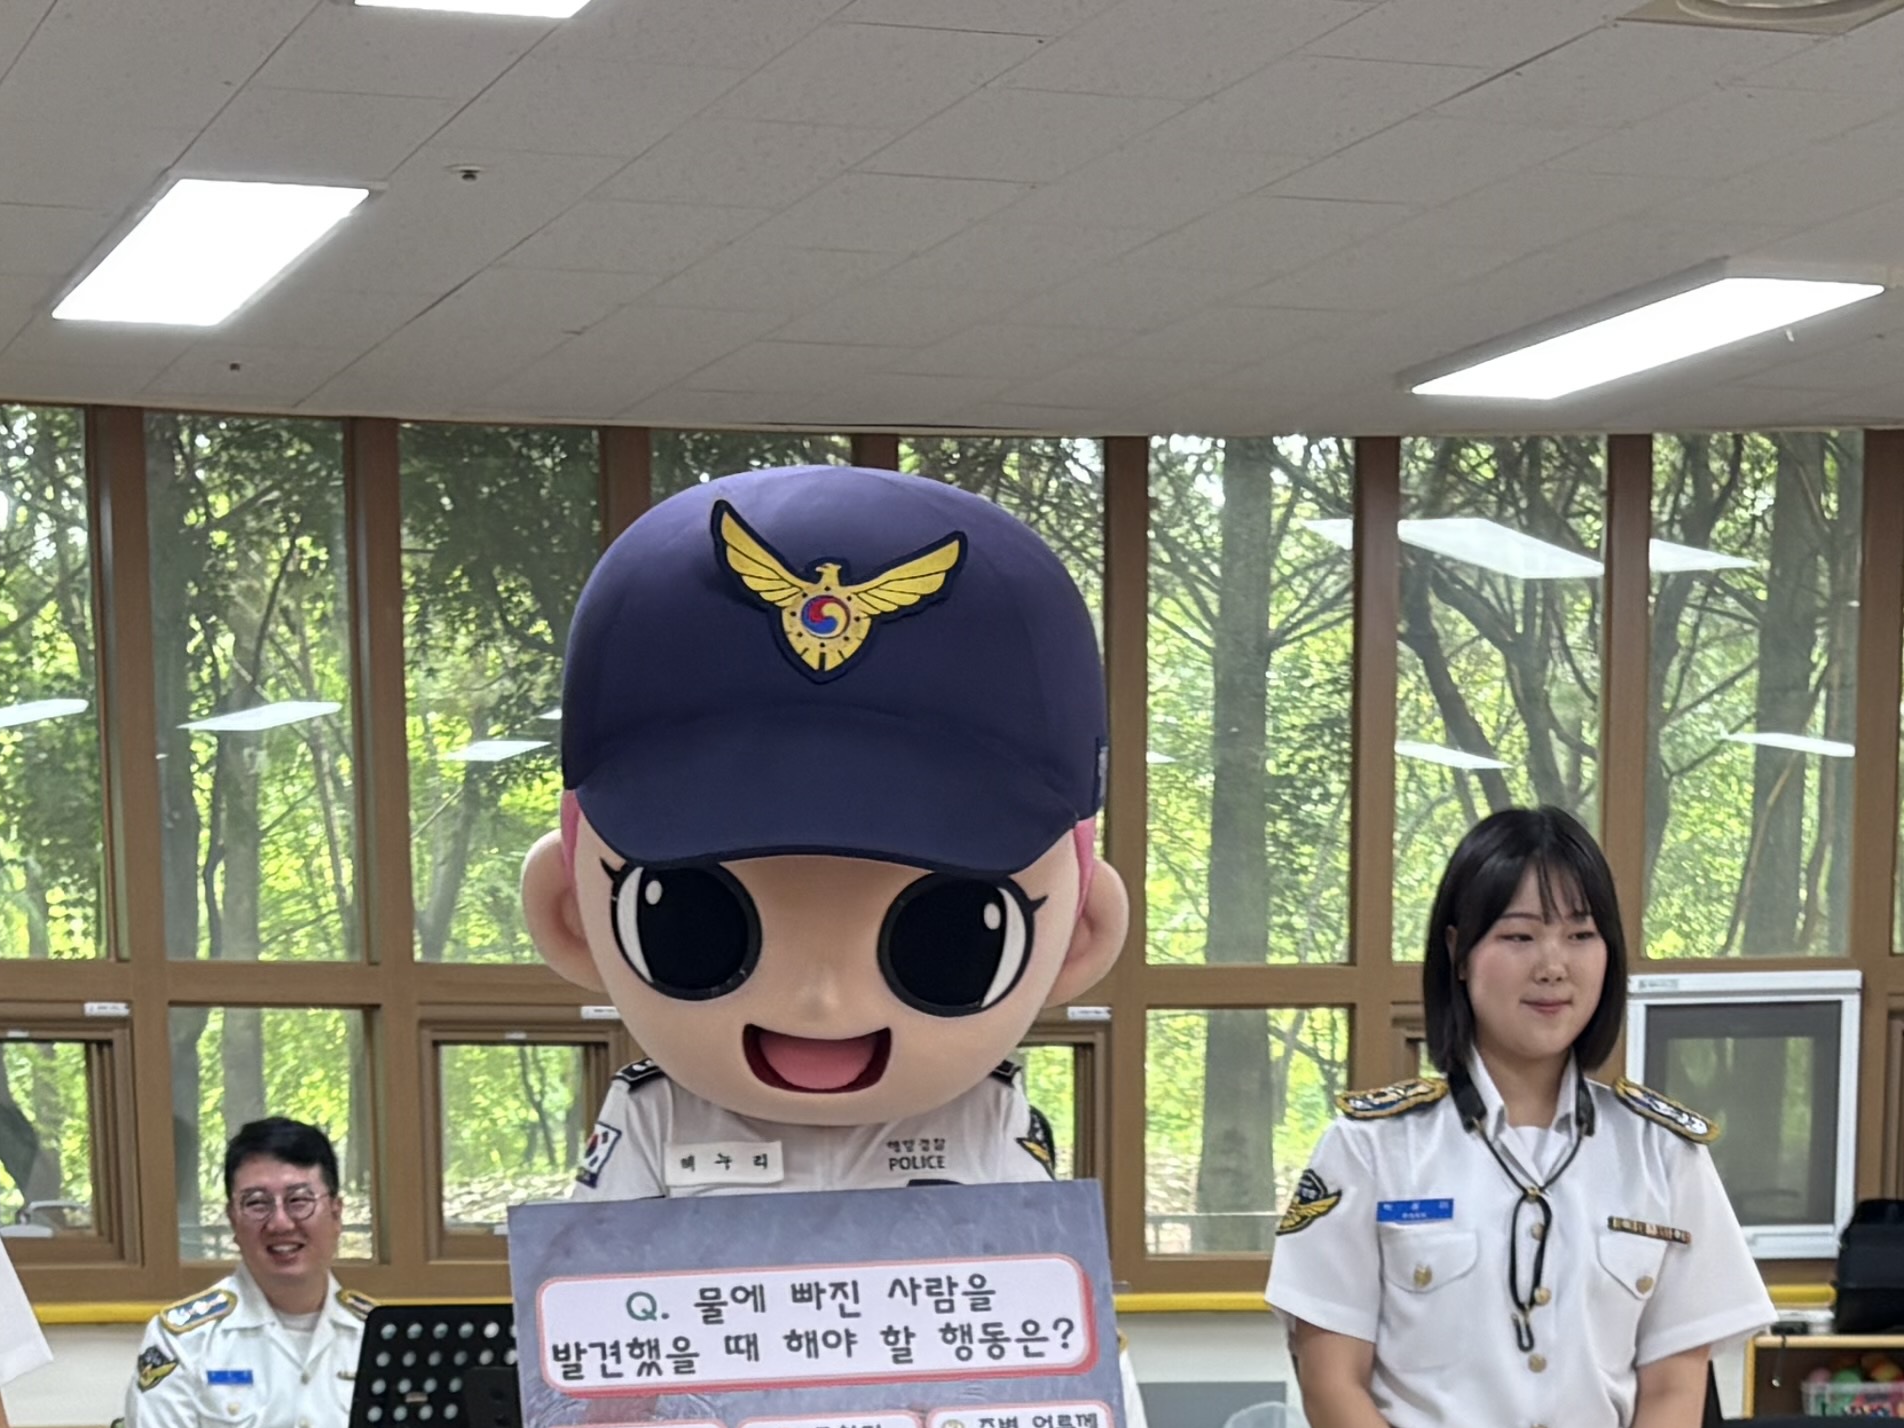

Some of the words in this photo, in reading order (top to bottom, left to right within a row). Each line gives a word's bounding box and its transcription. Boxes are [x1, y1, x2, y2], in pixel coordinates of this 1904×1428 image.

[889, 1155, 945, 1171] POLICE
[626, 1291, 670, 1321] Q.
[693, 1284, 766, 1325] 물에
[790, 1279, 861, 1318] 빠진
[888, 1272, 996, 1314] 사람을
[552, 1336, 700, 1382] 발견했을
[725, 1333, 759, 1361] 때
[784, 1328, 859, 1359] 해야
[881, 1323, 916, 1365] 할
[939, 1317, 1074, 1361] 행동은?
